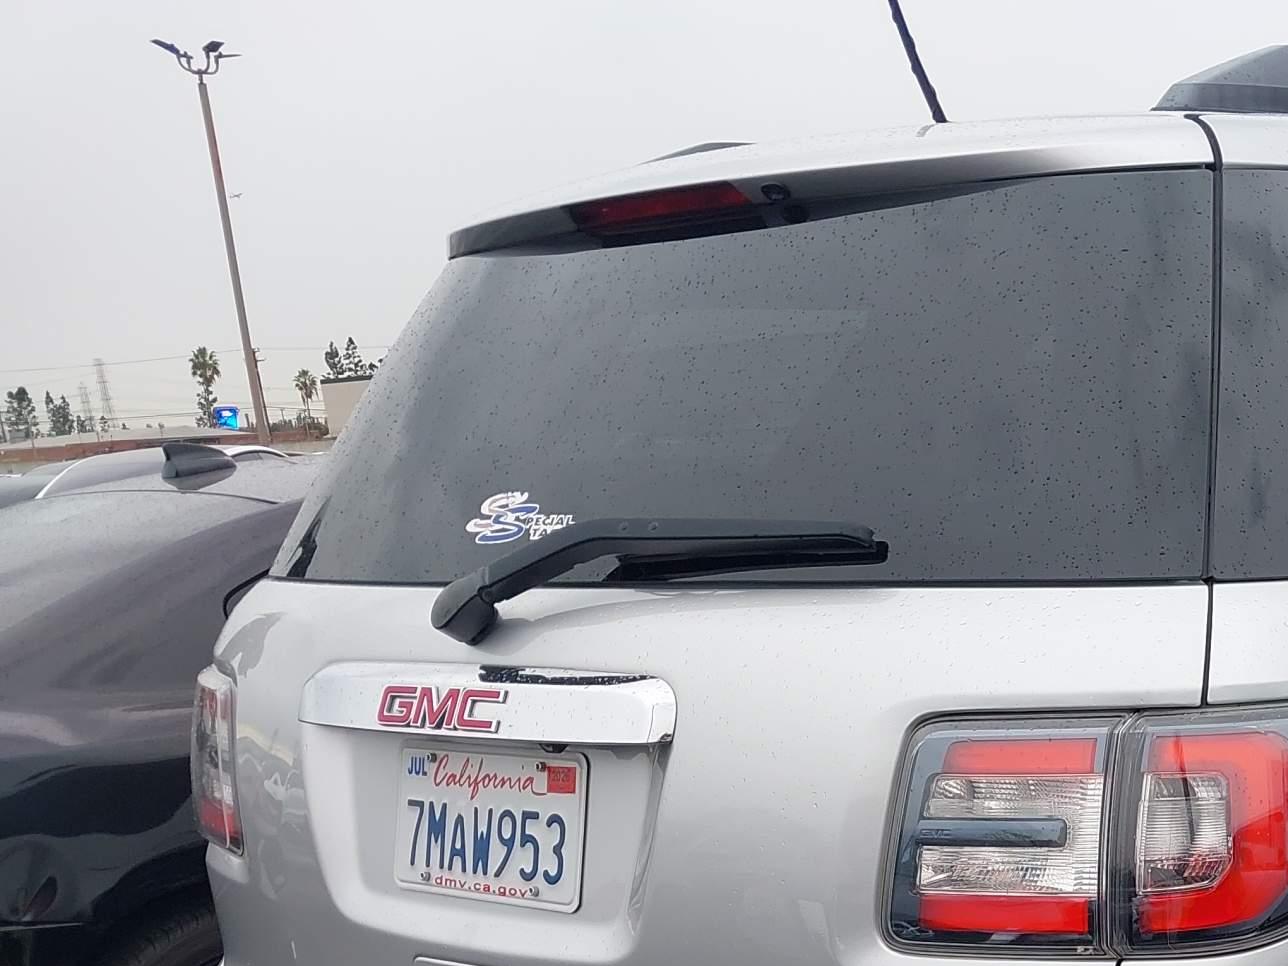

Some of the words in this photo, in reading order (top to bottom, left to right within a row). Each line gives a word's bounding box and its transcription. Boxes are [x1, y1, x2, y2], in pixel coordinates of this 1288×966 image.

[376, 684, 508, 734] GMC
[407, 756, 428, 777] JUL
[433, 754, 547, 801] California
[407, 798, 567, 886] 7MAW953
[434, 874, 530, 899] dmv.ca.gov
